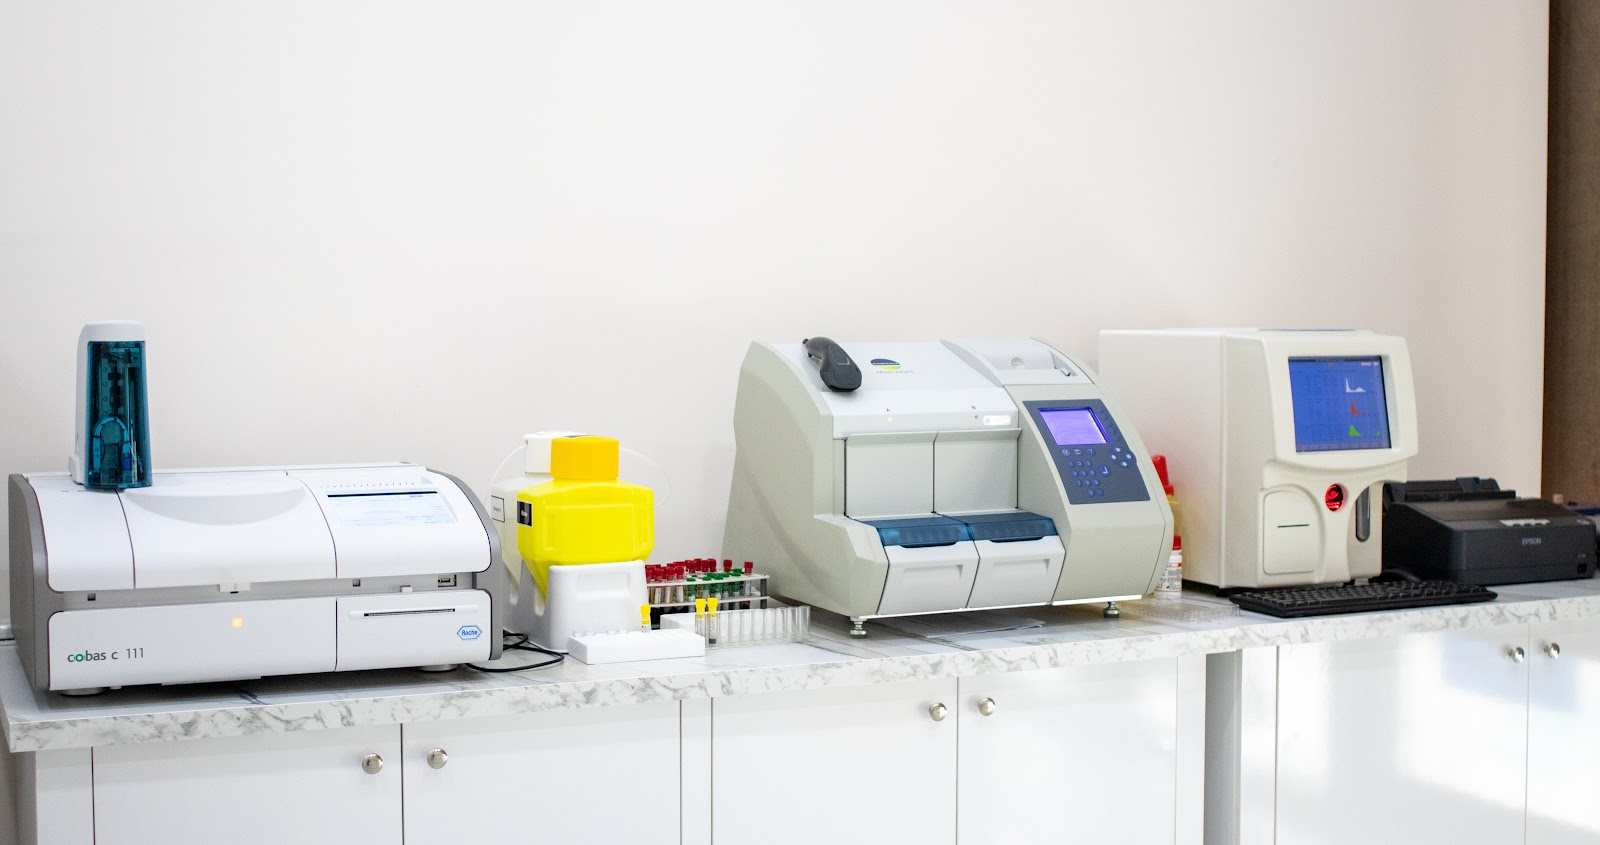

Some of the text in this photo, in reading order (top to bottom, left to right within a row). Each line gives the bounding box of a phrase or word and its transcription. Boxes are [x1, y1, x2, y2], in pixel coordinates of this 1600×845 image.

[1521, 537, 1542, 545] EPSON
[67, 647, 144, 663] cobas c 111
